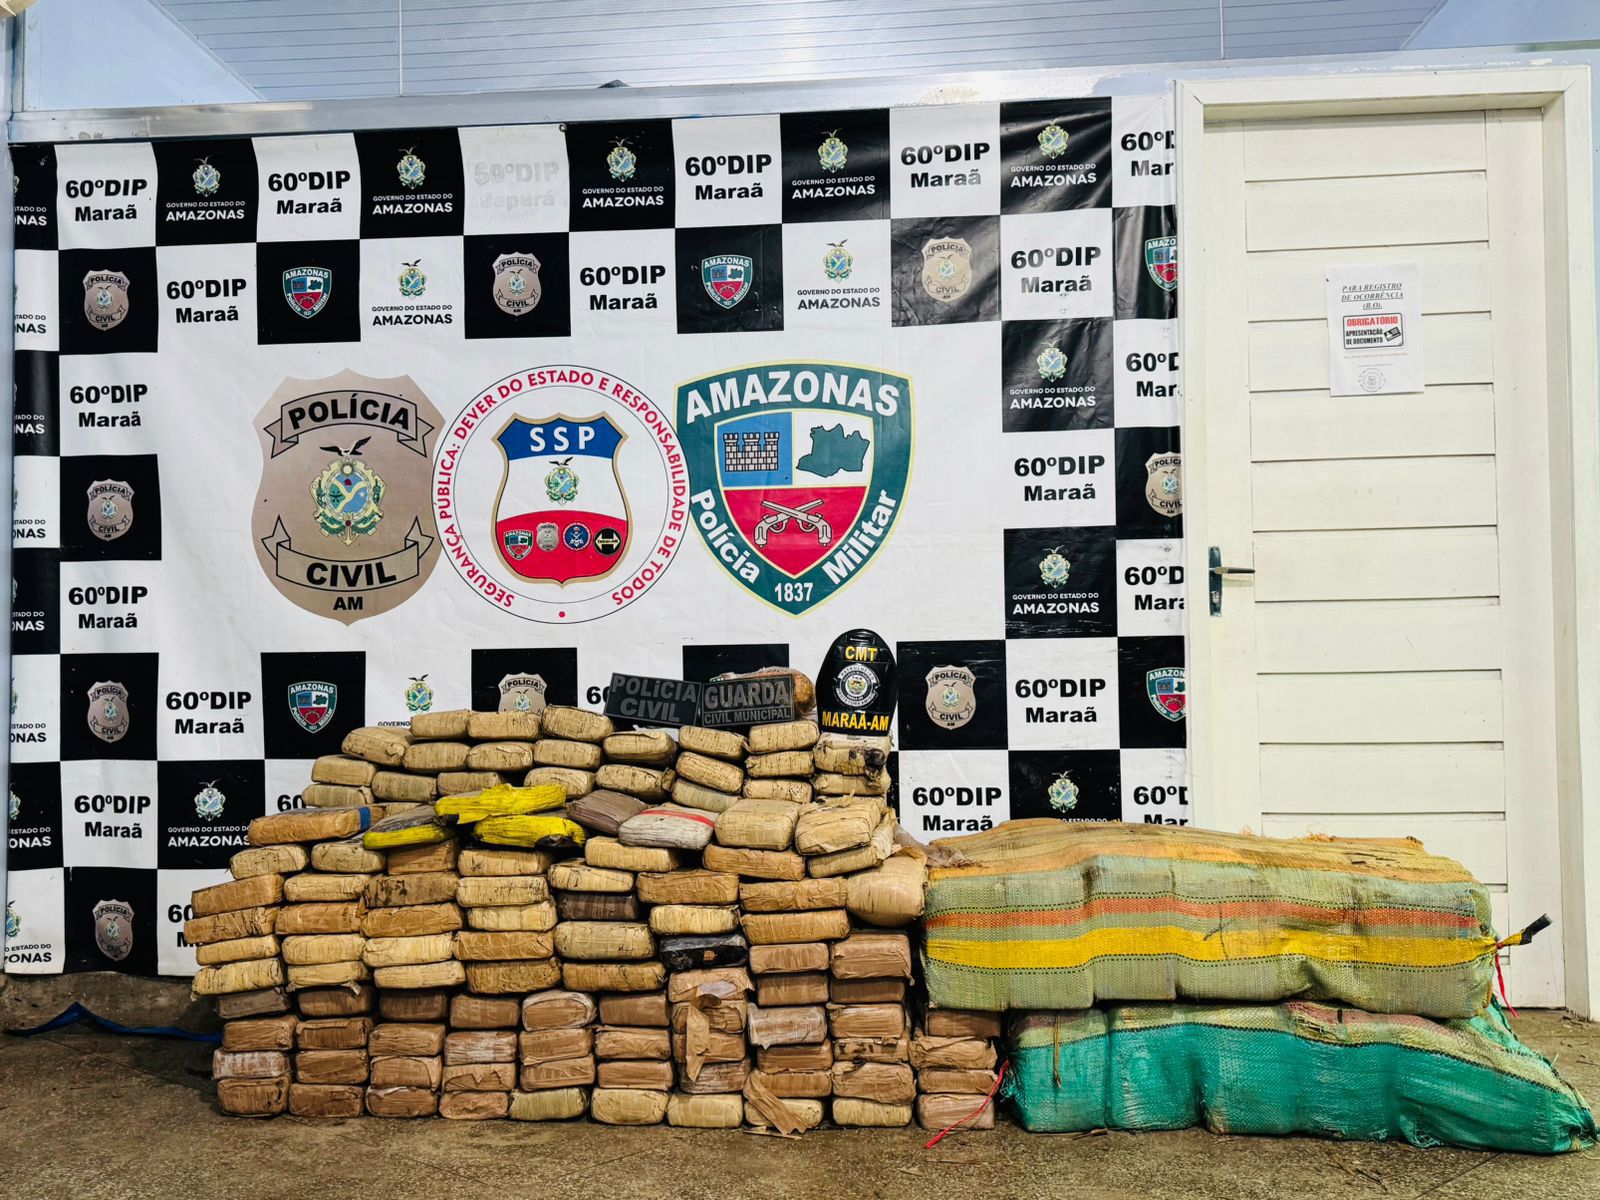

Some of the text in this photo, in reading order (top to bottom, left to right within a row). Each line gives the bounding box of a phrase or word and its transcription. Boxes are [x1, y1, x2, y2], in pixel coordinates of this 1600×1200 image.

[1131, 160, 1174, 176] Mar
[792, 178, 824, 186] GOVERNO
[911, 169, 981, 188] Maraã
[1011, 173, 1097, 188] AMAZONAS
[696, 183, 763, 200] Maraã
[792, 184, 875, 199] AMAZONAS
[277, 198, 342, 214] Maraã
[373, 202, 452, 214] AMAZONAS
[583, 195, 663, 208] AMAZONAS
[75, 204, 136, 221] Maraã
[166, 209, 244, 221] AMAZONAS
[1148, 238, 1176, 250] AMAZO
[501, 258, 533, 268] POLÍCIA
[704, 256, 750, 267] AMAZONAS
[89, 275, 122, 285] POLÍCIA
[285, 269, 328, 280] AMAZONAS
[1021, 275, 1092, 293] Maraã
[1364, 283, 1401, 291] REGISTRO
[506, 299, 529, 308] CIVIL
[590, 293, 657, 310] Maraã
[798, 297, 880, 310] AMAZONAS
[1354, 292, 1403, 300] OCORRÊNCIA
[95, 314, 116, 322] CIVIL
[176, 306, 238, 323] Maraã
[373, 314, 452, 326] AMAZONAS
[1347, 316, 1398, 326] OBRIGATÓRIO
[1346, 328, 1382, 337] APRESENTAÇÃO
[528, 370, 594, 387] ESTADO
[599, 378, 609, 391] E
[498, 379, 523, 399] DO
[1136, 380, 1179, 397] Mar
[686, 370, 899, 425] AMAZONAS
[1010, 395, 1096, 409] AMAZONAS
[79, 411, 141, 427] Maraã
[288, 394, 409, 430] POLÍCIA
[454, 395, 497, 440] DEVER
[613, 383, 686, 532] RESPONSABILIDADE
[94, 485, 126, 494] POLÍCIA
[434, 444, 460, 520] PÚBLICA:
[1025, 484, 1095, 501] Maraã
[691, 489, 897, 585] Polícia Militar
[657, 536, 676, 558] DE
[444, 524, 515, 608] SEGURANÇA
[306, 562, 396, 587] CIVIL
[1124, 566, 1184, 586] 60ºD
[612, 560, 663, 606] TODOS
[774, 582, 813, 602] 1837
[333, 597, 363, 610] AM
[1013, 602, 1099, 614] AMAZONAS
[79, 613, 137, 628] Maraã
[845, 646, 877, 661] CMT
[935, 671, 967, 680] POLÍCIA
[1149, 670, 1185, 680] AMAZON
[290, 683, 334, 694] AMAZONAS
[507, 678, 539, 688] POLÍCIA
[97, 687, 123, 695] POLÍCIA
[704, 679, 790, 708] GUARDA
[620, 699, 680, 722] CIVIL
[704, 708, 790, 725] CIVIL MUNICIPAL
[940, 712, 964, 720] CIVIL
[1026, 707, 1097, 723] Maraã
[175, 718, 244, 734] Maraã
[85, 822, 142, 838] Maraã
[923, 815, 993, 831] Maraã
[101, 907, 127, 915] POLÍCIA
